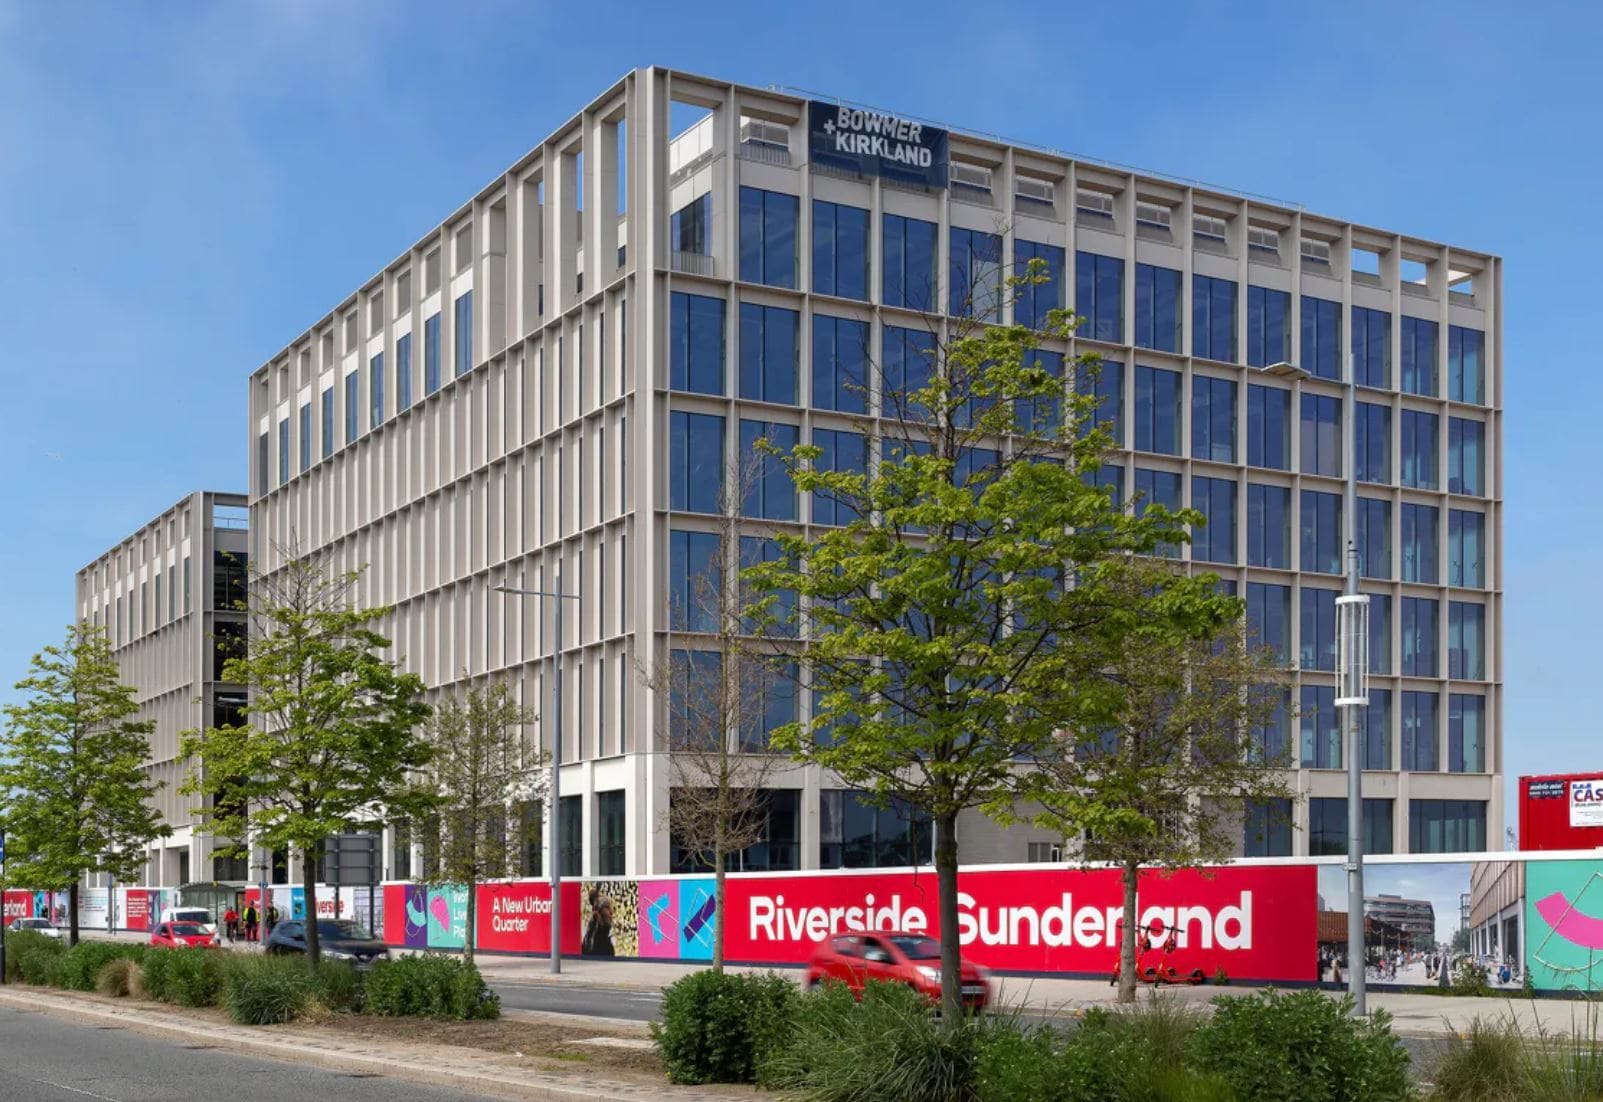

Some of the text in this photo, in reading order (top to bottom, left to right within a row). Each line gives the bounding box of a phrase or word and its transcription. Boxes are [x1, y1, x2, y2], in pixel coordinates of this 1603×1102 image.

[837, 107, 923, 143] BOWMER
[835, 130, 932, 167] KIRKLAND
[492, 896, 500, 913] A
[502, 896, 523, 913] New
[750, 893, 928, 942] Riverside
[492, 915, 529, 932] Quarter
